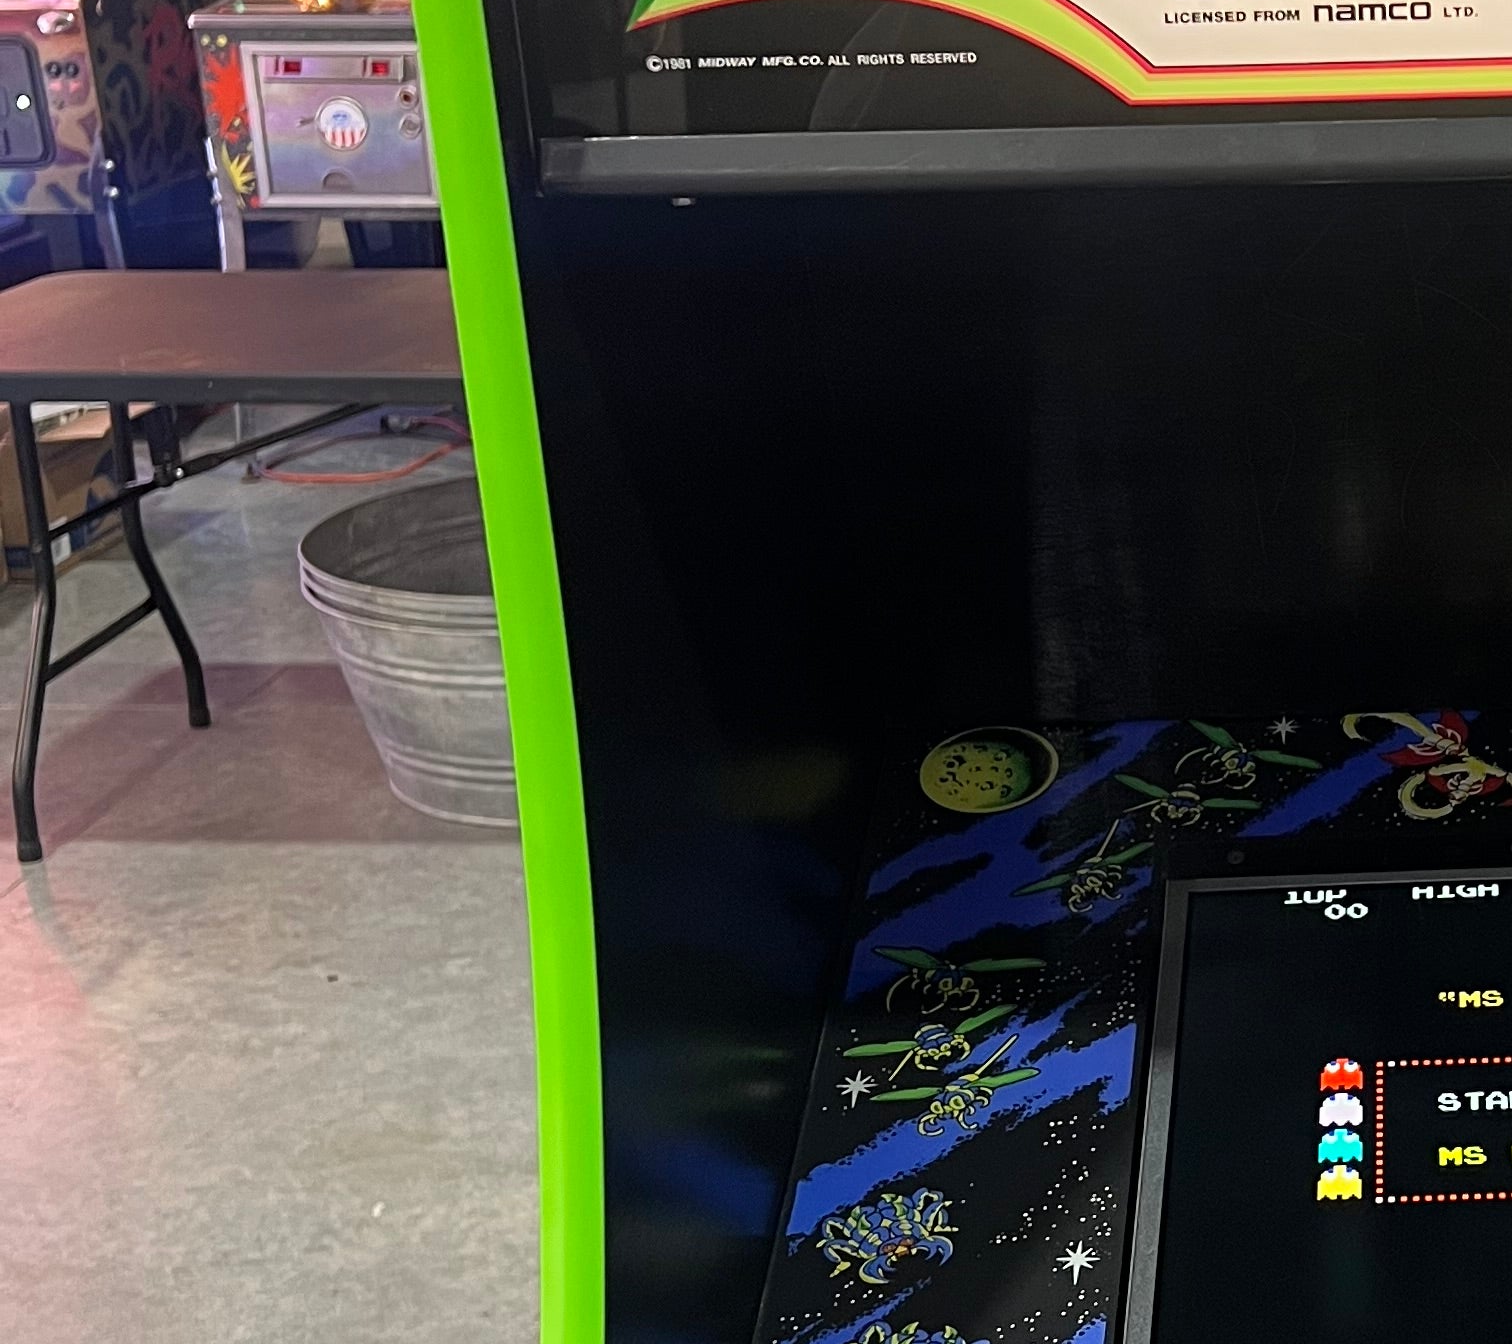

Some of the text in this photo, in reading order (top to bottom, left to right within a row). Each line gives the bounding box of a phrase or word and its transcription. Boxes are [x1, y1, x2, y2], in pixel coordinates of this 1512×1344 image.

[1164, 2, 1480, 24] LICENSED FROM namco LTD.
[698, 56, 757, 68] MIDWAY
[799, 56, 825, 67] CO.
[828, 54, 850, 66] ALL
[857, 53, 905, 66] RIGHTS
[910, 52, 977, 64] RESERVED
[1324, 902, 1369, 920] 00
[1438, 1145, 1487, 1167] MS
